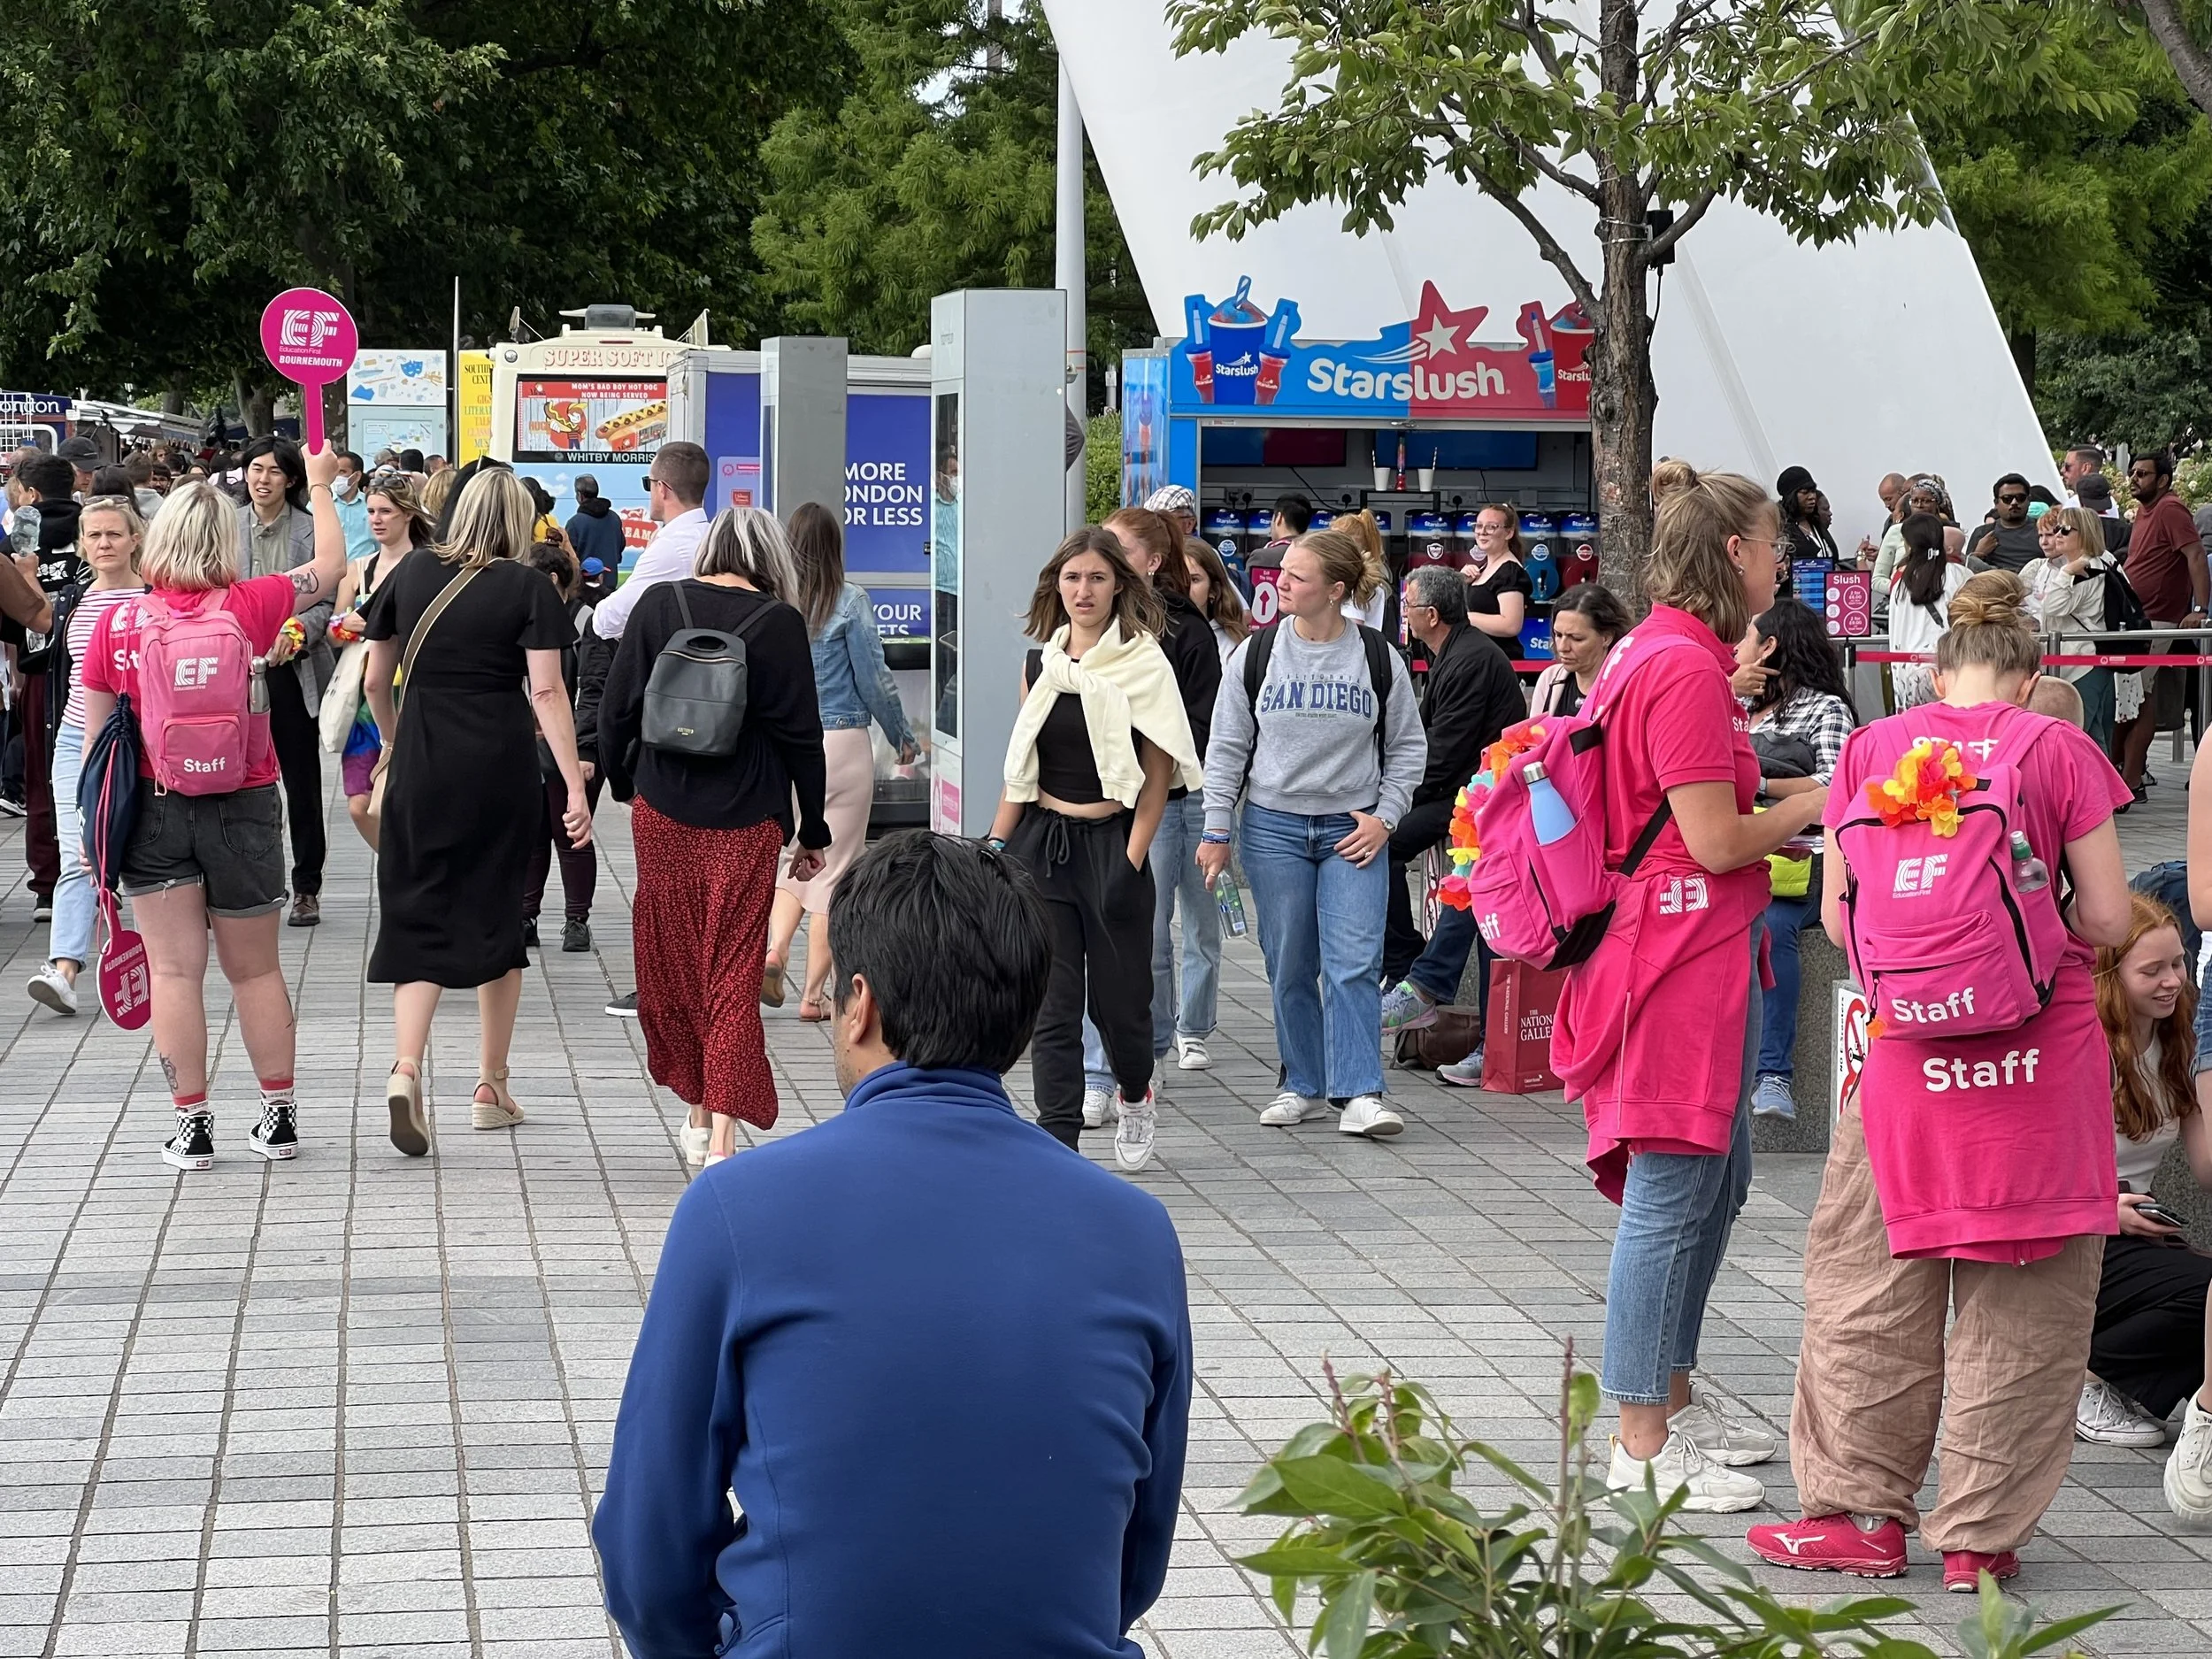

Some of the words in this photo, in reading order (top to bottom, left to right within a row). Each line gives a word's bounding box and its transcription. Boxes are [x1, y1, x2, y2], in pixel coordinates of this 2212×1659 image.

[280, 310, 340, 347] EF
[279, 355, 342, 367] BOURNEMOUTH
[544, 348, 603, 368] SUPER
[607, 349, 653, 367] SOFT
[1216, 364, 1259, 376] Starslush
[1557, 369, 1591, 381] Starslu
[1307, 357, 1505, 401] Starslush
[567, 453, 611, 462] WHITBY
[612, 453, 656, 463] MORRIS
[845, 462, 906, 481] MORE
[872, 507, 923, 526] LESS
[1833, 574, 1861, 584] Slush
[174, 657, 219, 686] EF
[1279, 673, 1361, 684] CALIFORNIA
[1261, 680, 1307, 714] SAN
[1308, 681, 1373, 721] DIEGO
[183, 757, 226, 772] Staff
[1893, 853, 1948, 893] EF
[1892, 890, 1920, 899] Education
[1479, 912, 1501, 941] aff
[1891, 987, 1975, 1024] Staff
[1520, 1014, 1553, 1028] NATION
[1520, 1026, 1553, 1041] GALLE
[1839, 1058, 1844, 1072] NO
[1922, 1048, 2039, 1093] Staff
